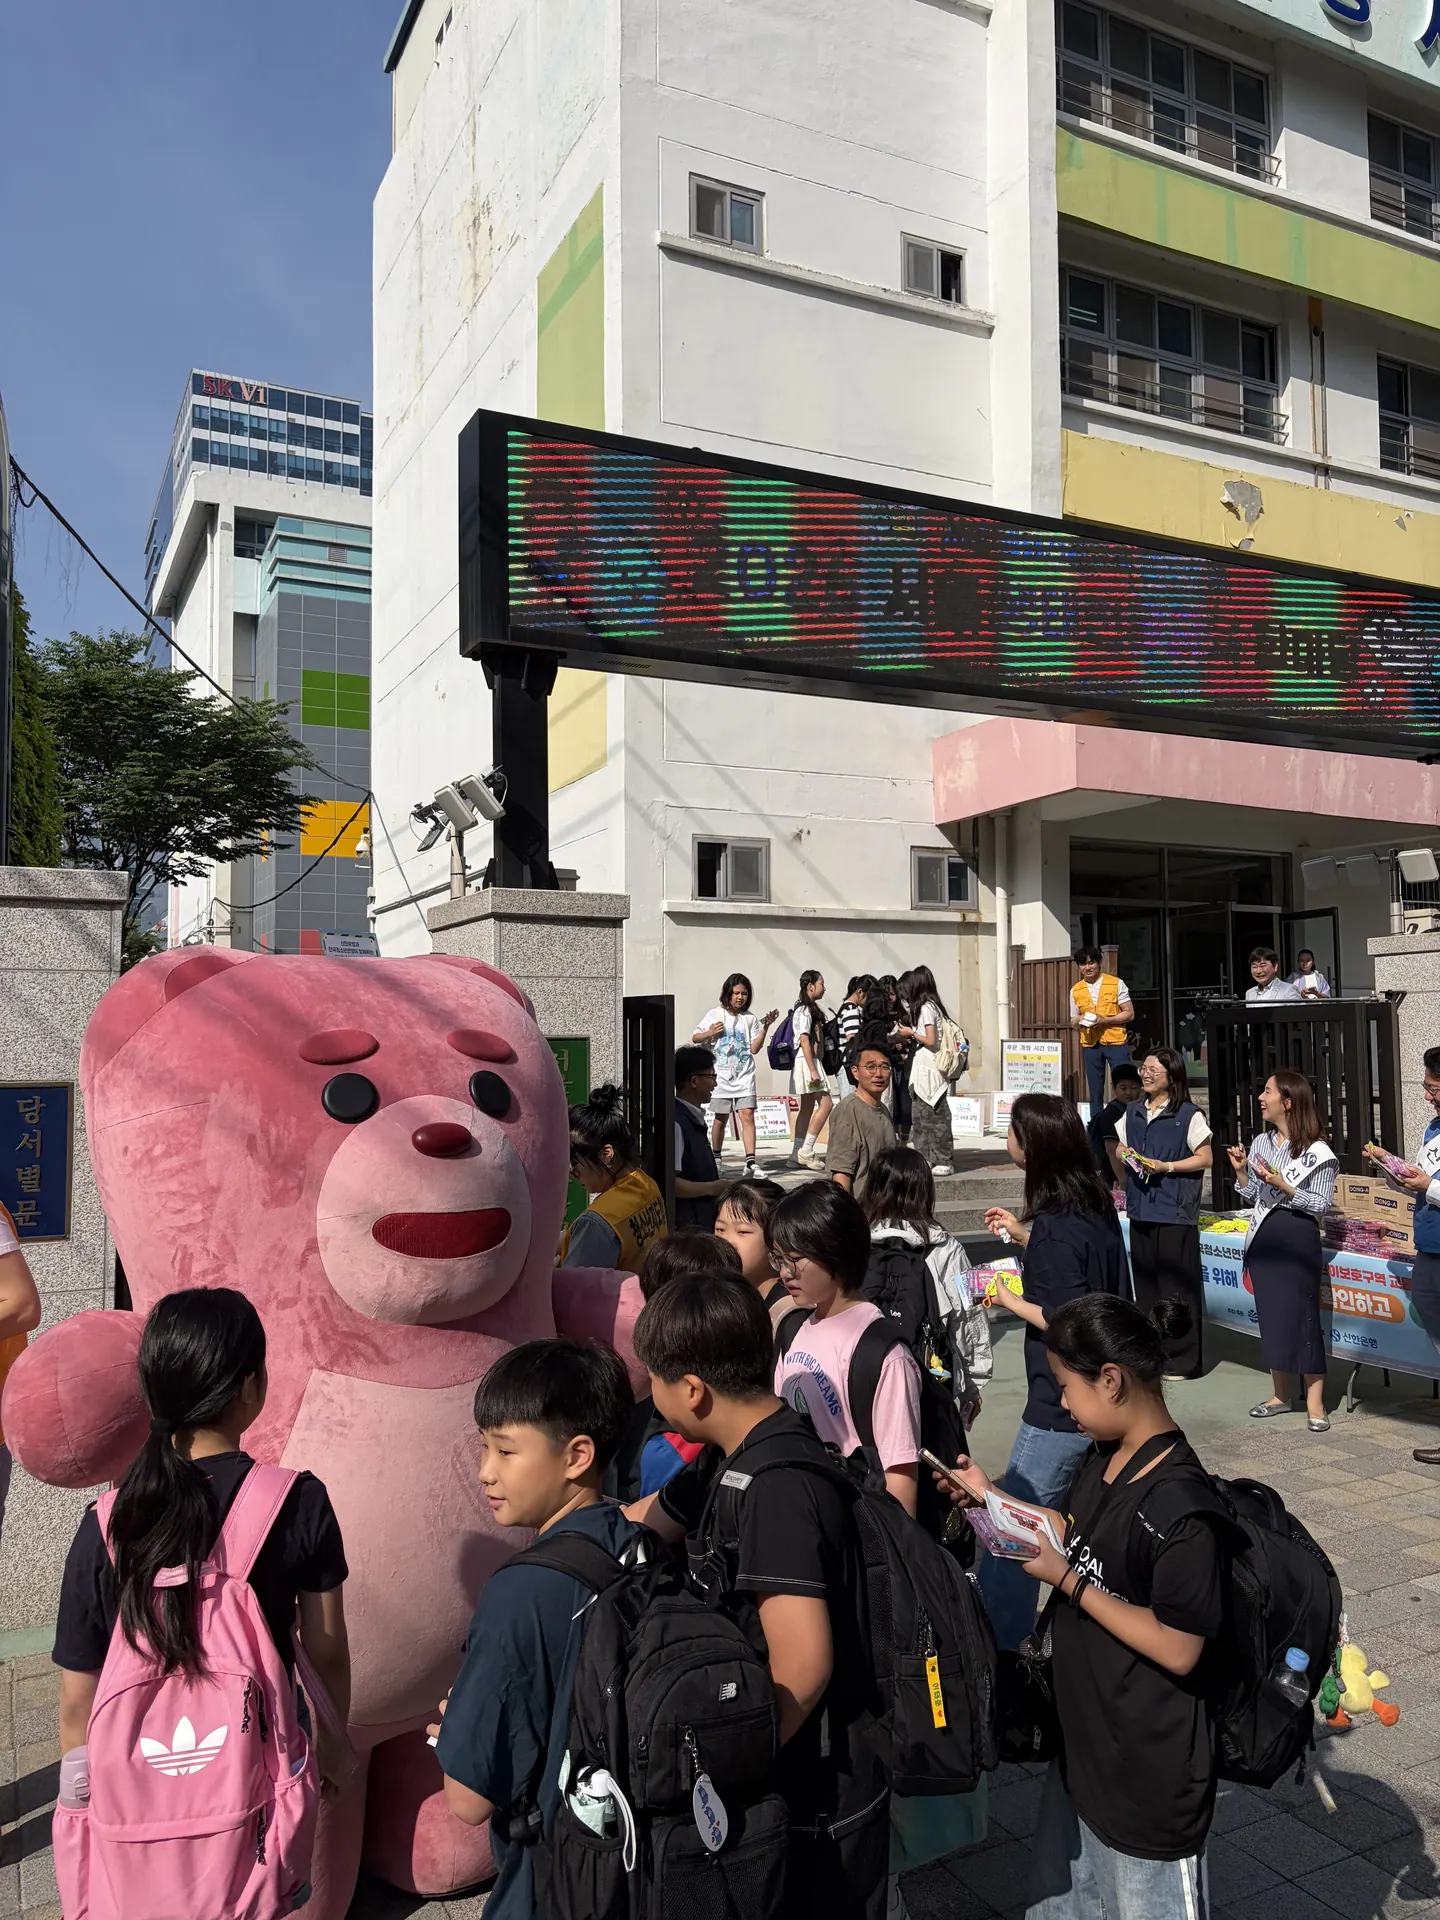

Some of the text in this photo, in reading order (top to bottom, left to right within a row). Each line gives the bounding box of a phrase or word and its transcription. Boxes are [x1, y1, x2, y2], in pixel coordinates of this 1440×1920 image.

[203, 376, 233, 399] SK
[1349, 1186, 1370, 1194] DONG-A
[1374, 1198, 1398, 1209] DONG-A
[1386, 1230, 1409, 1240] DONG-A
[1212, 1267, 1239, 1289] 위해
[1342, 1332, 1378, 1349] 신한은행
[786, 1351, 842, 1416] WITH BIG DREAMS
